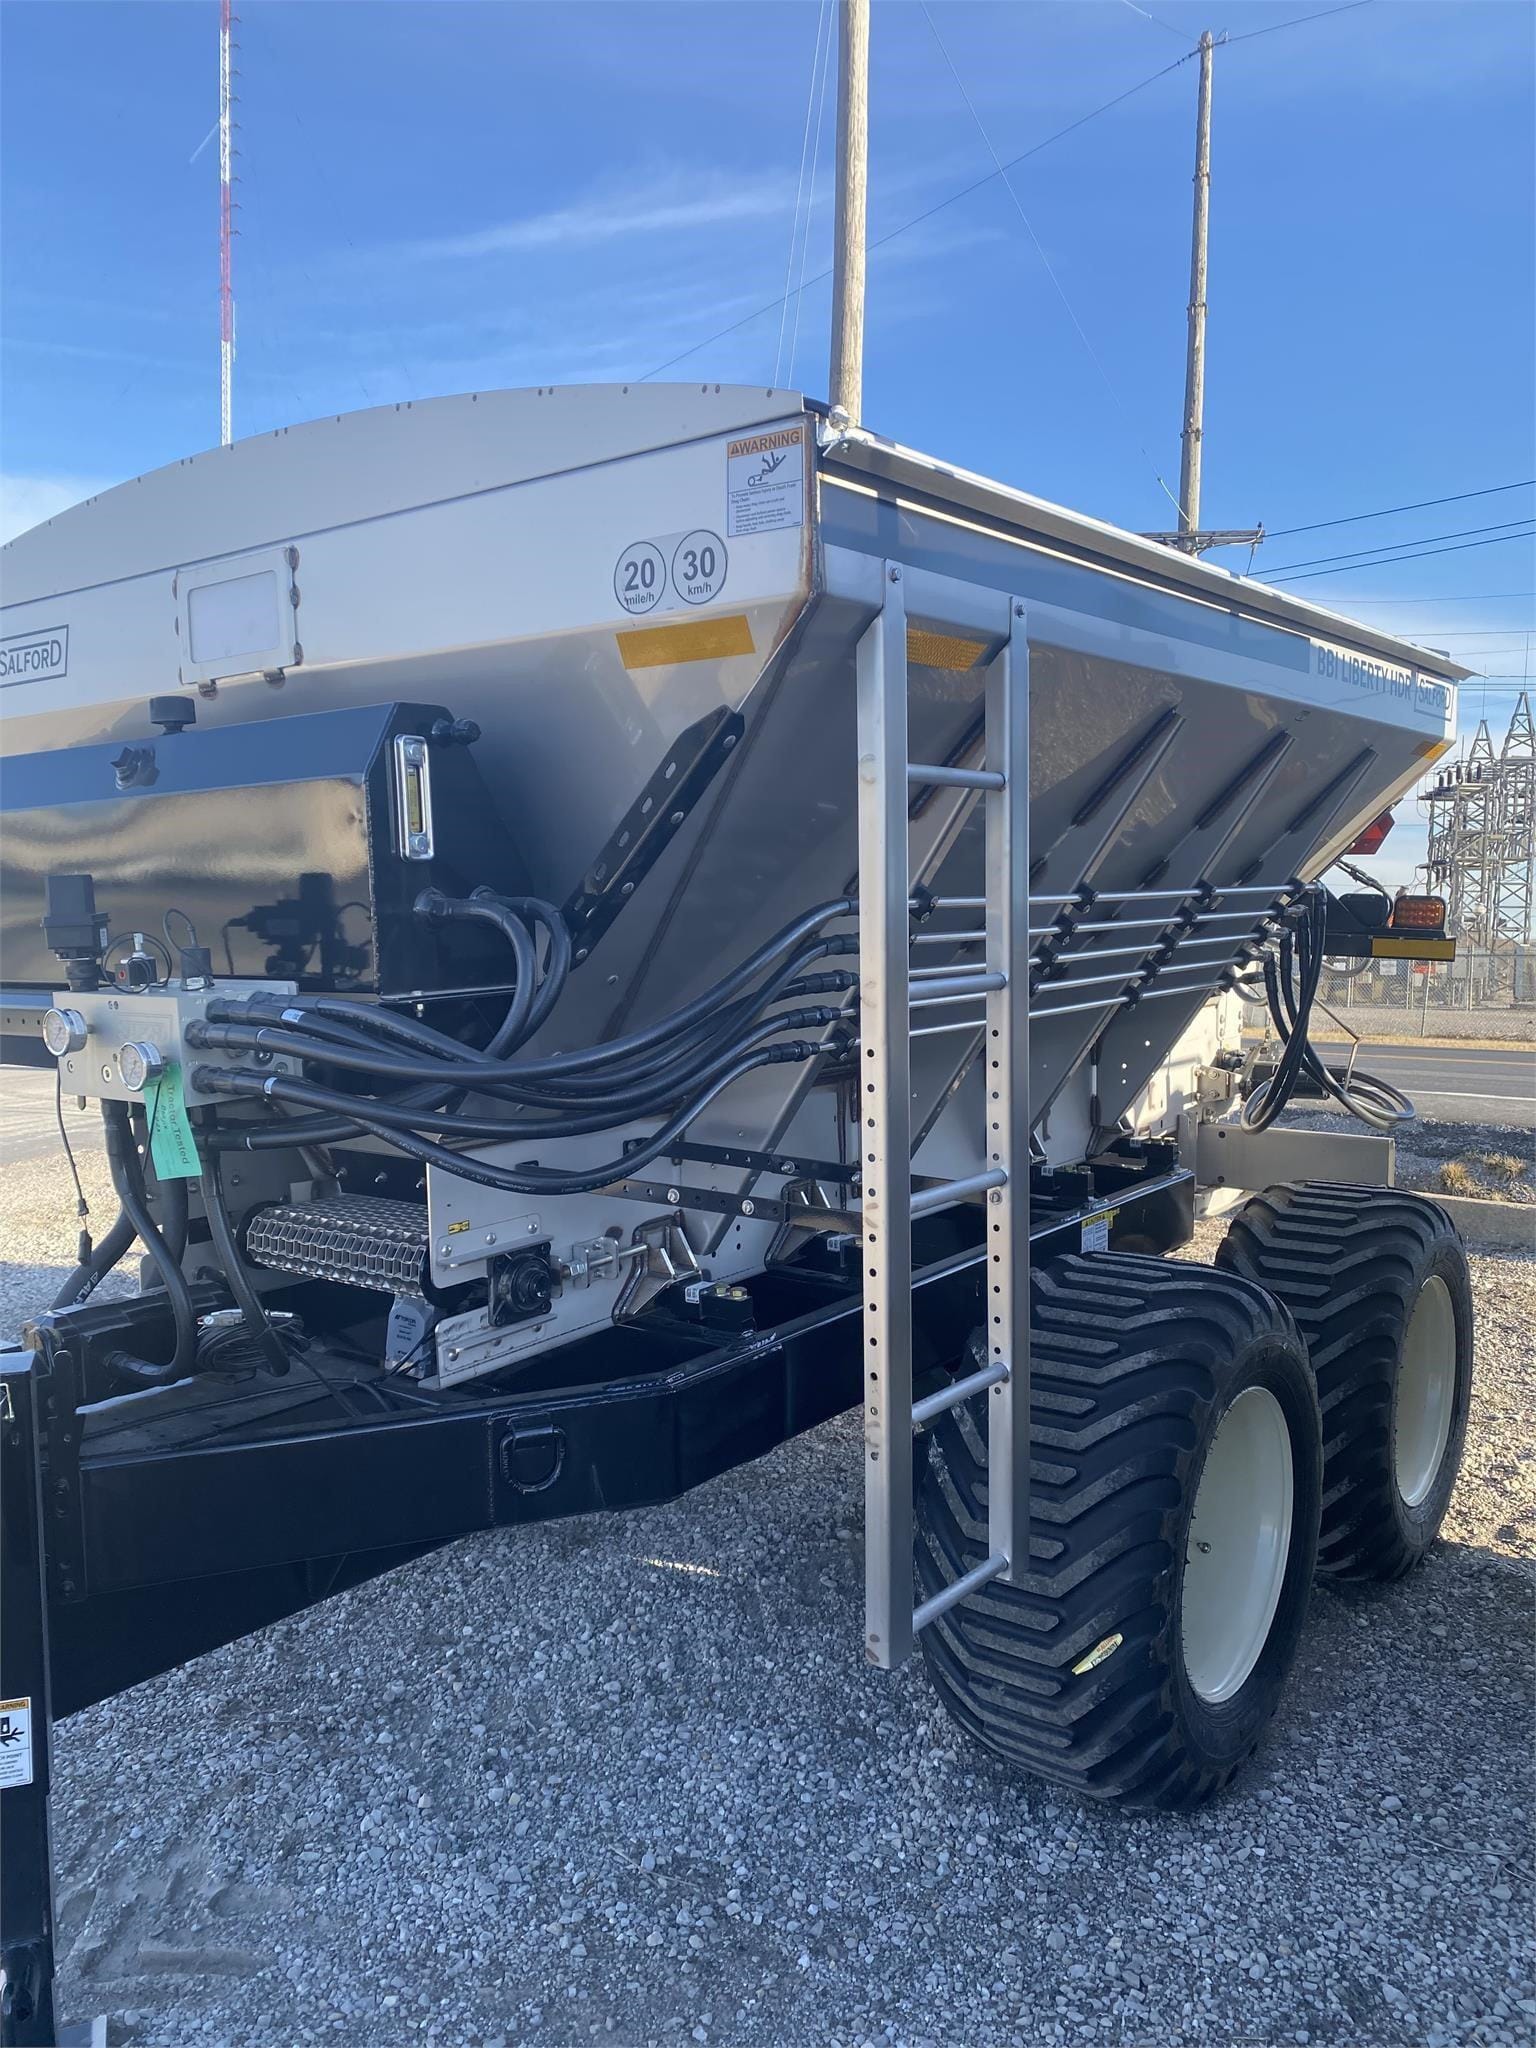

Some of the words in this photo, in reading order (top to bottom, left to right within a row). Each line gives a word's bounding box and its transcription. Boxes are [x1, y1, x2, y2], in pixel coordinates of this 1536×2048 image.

[740, 431, 800, 454] WARNING
[624, 558, 655, 592] 20
[683, 546, 716, 581] 30
[626, 592, 655, 606] mile/h
[688, 581, 712, 596] km/h
[0, 639, 62, 676] SALFORD
[1317, 646, 1338, 678] BBI
[1342, 654, 1389, 692] LIBERTY
[1390, 670, 1412, 701] HDR
[1419, 678, 1451, 711] SALFORD
[174, 1128, 190, 1164] Tested
[0, 1701, 26, 1711] ARNING
